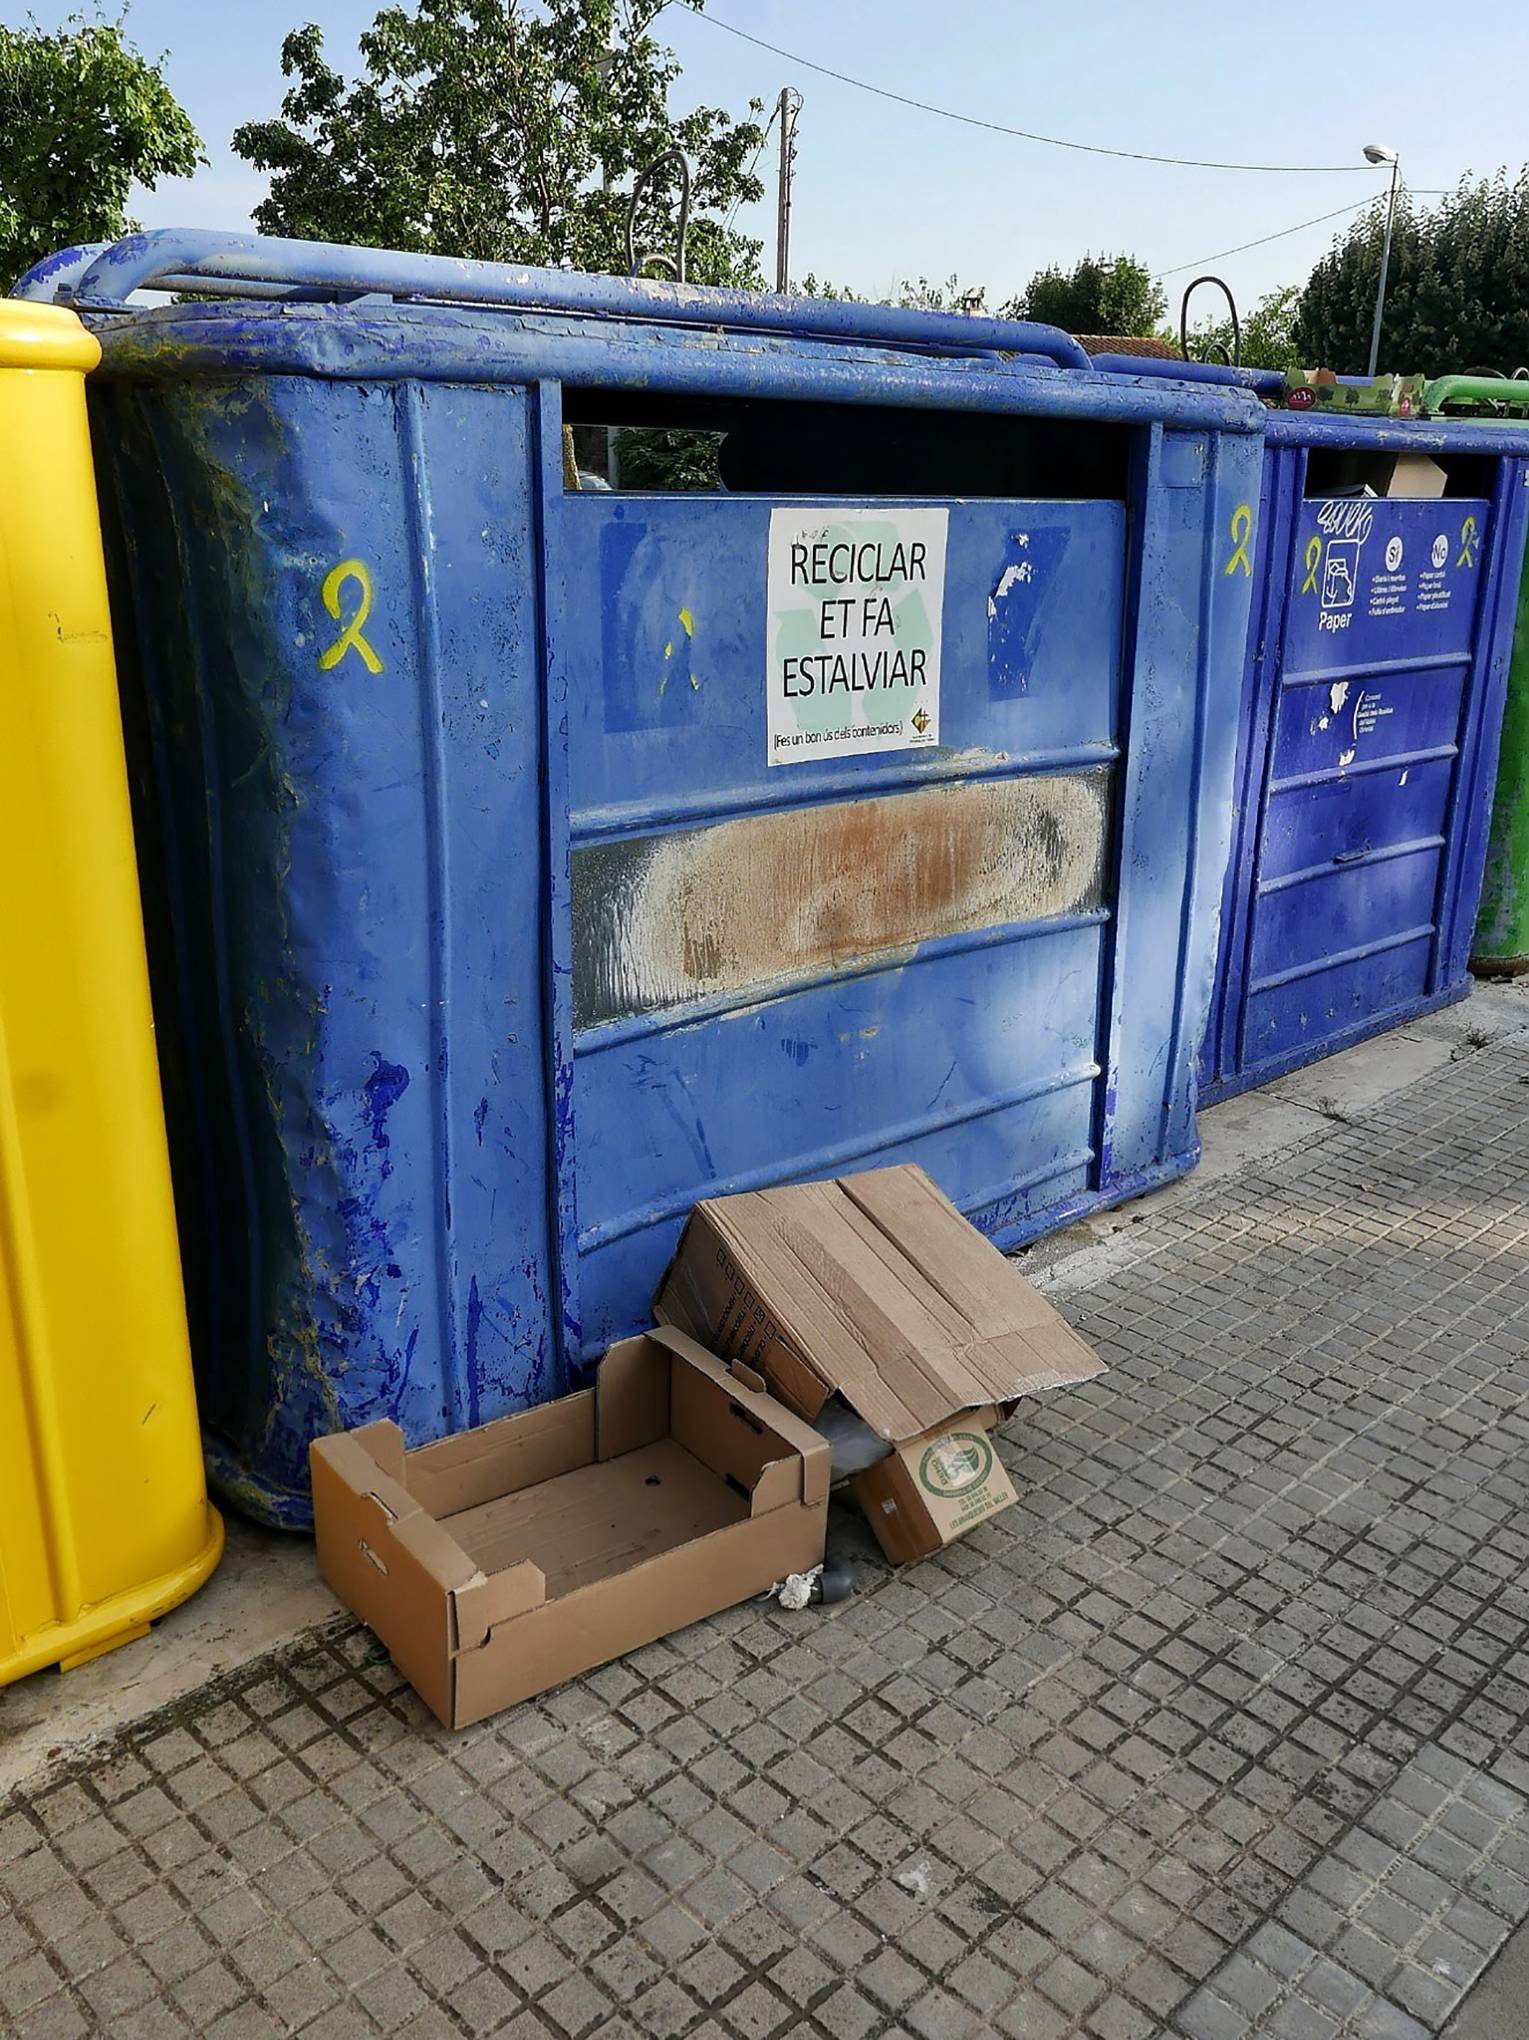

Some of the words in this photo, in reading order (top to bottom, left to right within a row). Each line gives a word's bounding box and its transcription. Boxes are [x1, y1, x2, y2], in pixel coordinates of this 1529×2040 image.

[791, 543, 926, 585] RECICLAR
[1433, 544, 1446, 560] No
[820, 600, 856, 639] ET
[862, 598, 895, 636] FA
[1318, 611, 1353, 633] Paper
[783, 649, 927, 697] ESTALVIAR
[792, 735, 804, 746] un
[805, 731, 822, 744] bon
[834, 726, 851, 740] dels
